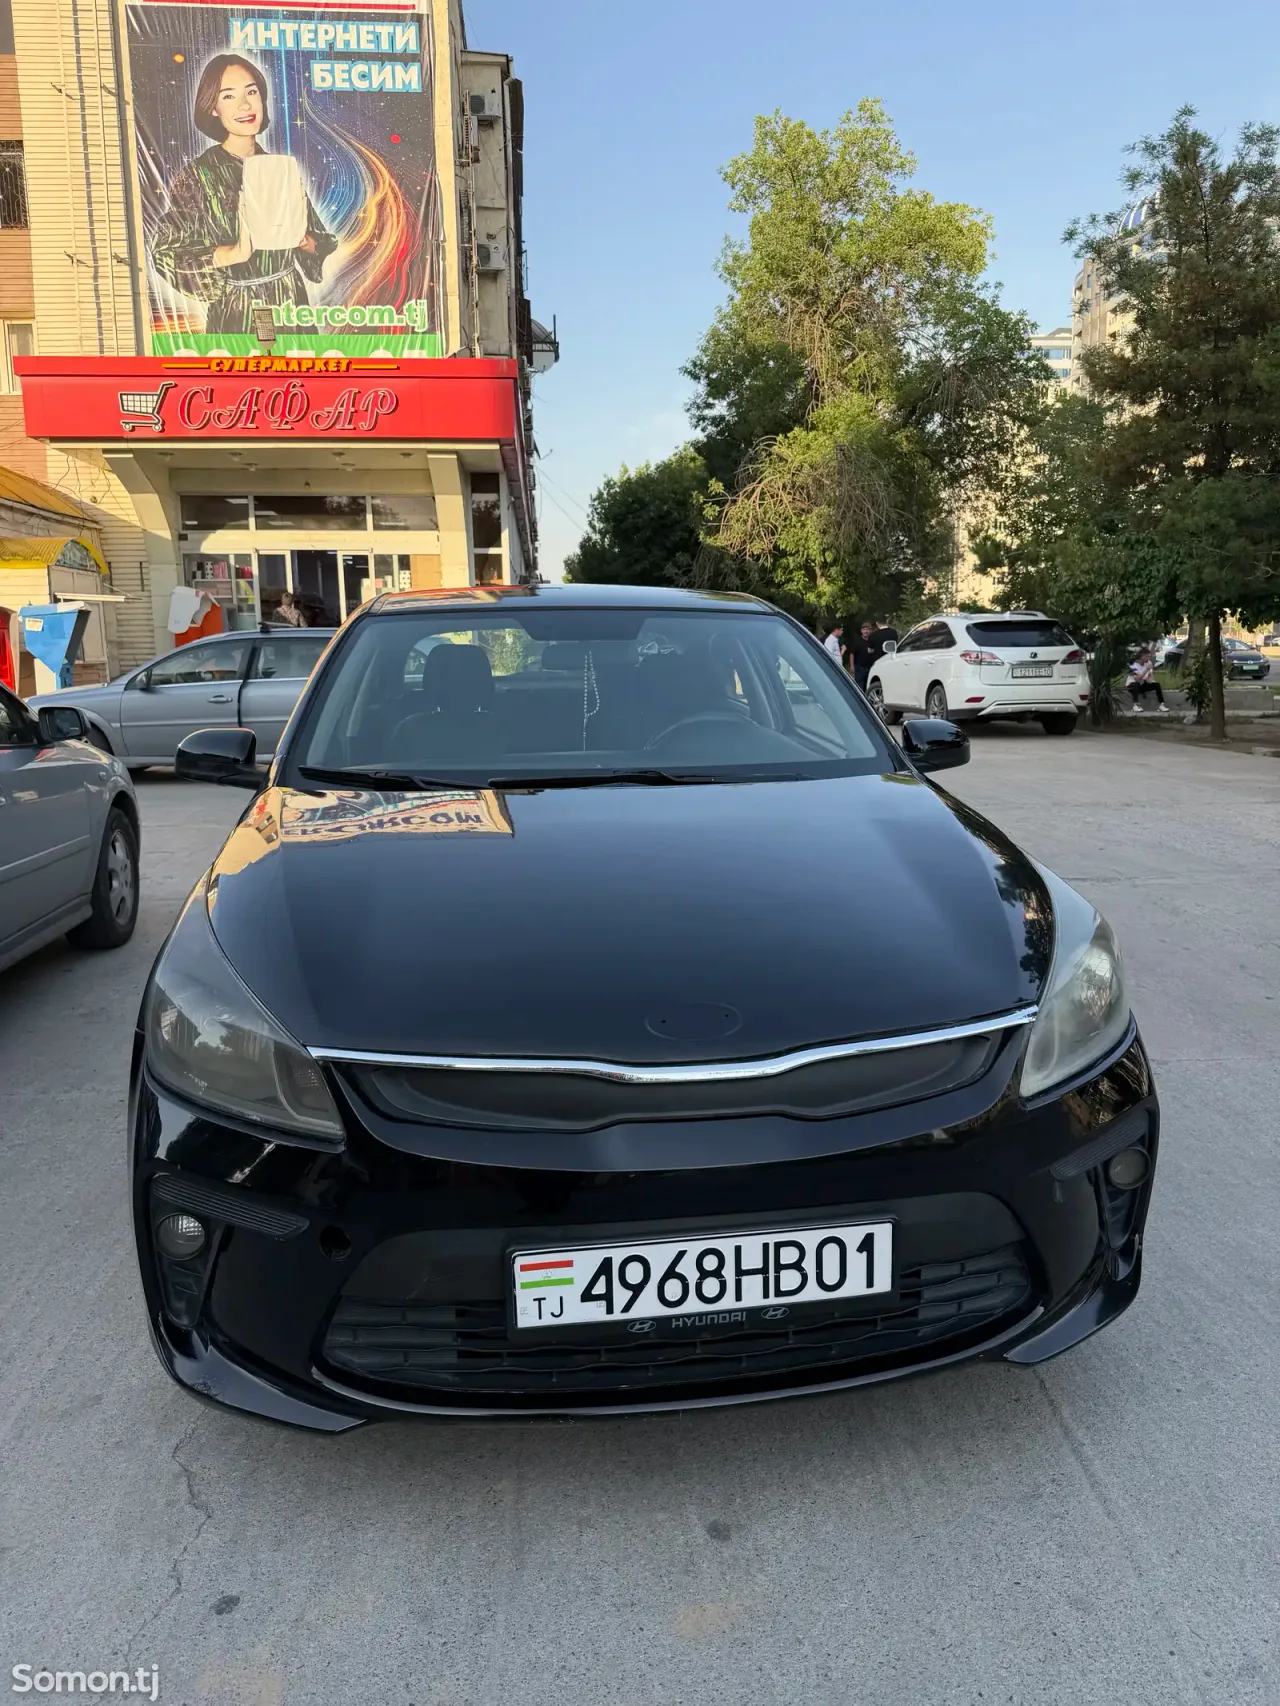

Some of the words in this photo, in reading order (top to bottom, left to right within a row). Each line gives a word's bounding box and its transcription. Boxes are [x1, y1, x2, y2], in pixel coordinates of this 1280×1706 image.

[231, 20, 418, 51] ИНТЕРНЕТИ
[313, 62, 420, 90] БЕСИМ
[252, 299, 428, 332] ntercom.tj
[210, 358, 351, 372] СУПЕРМАРКЕТ
[178, 380, 399, 431] САФАР
[533, 1295, 564, 1320] TJ
[580, 1232, 875, 1316] 4968HB01
[671, 1311, 746, 1328] HYUNDAI
